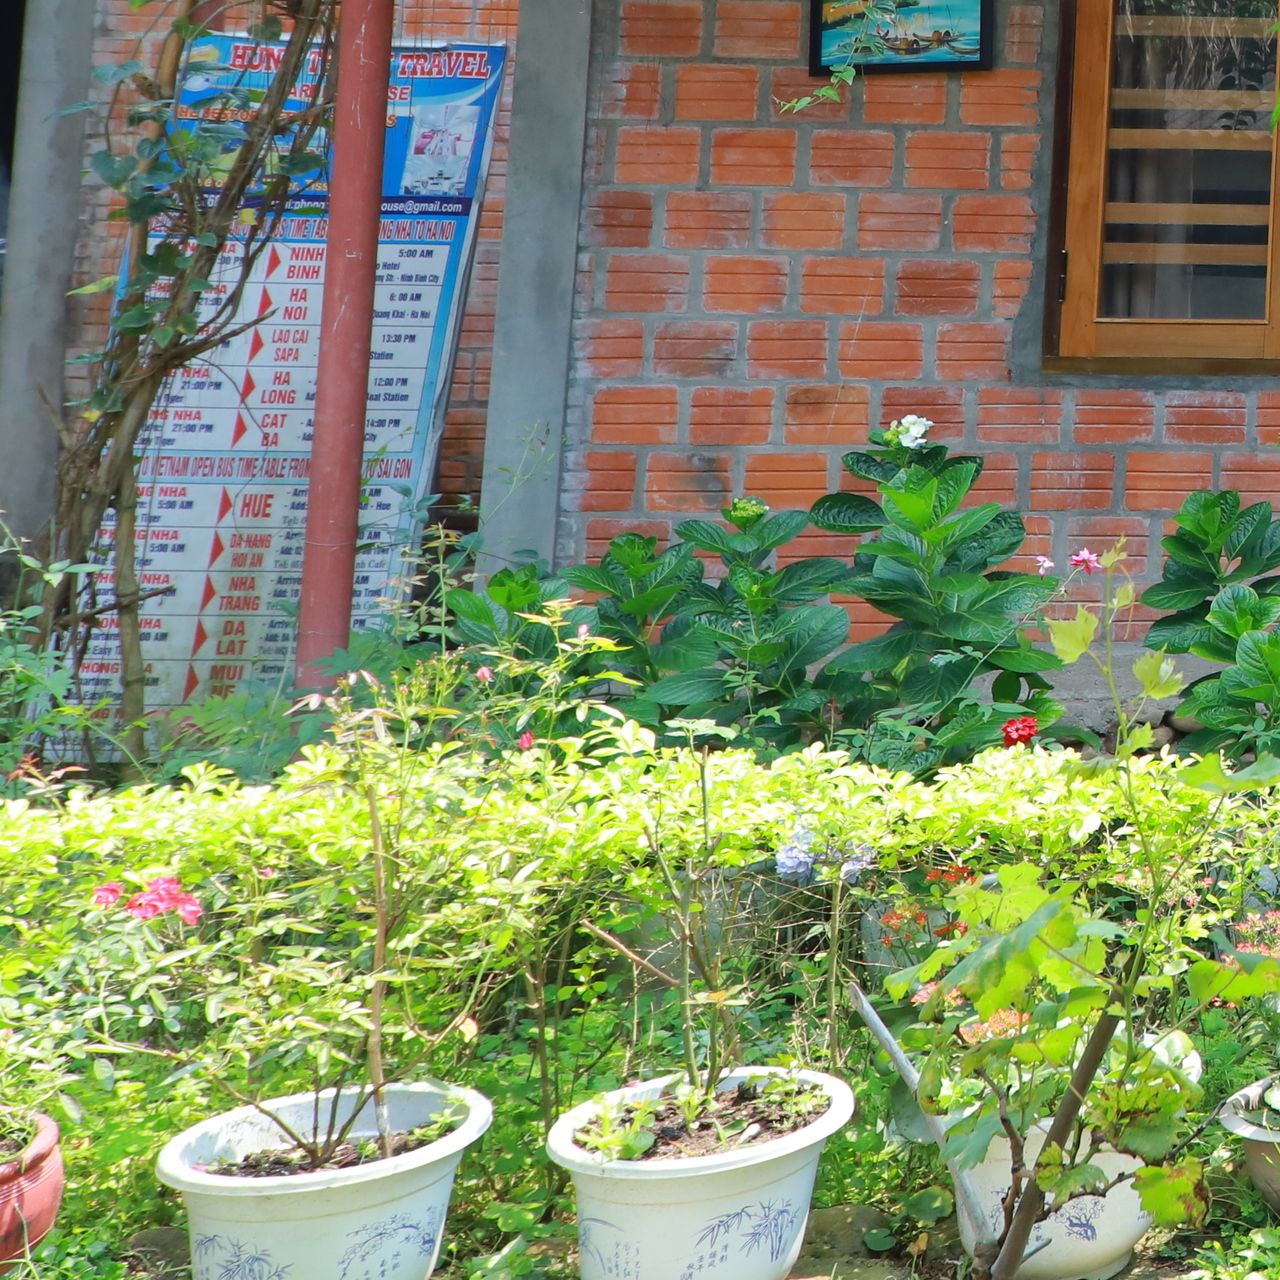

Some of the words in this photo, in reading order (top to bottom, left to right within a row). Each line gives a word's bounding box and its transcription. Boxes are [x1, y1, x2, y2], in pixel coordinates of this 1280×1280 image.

[229, 43, 287, 74] HUN
[397, 51, 492, 79] TRAVEL
[381, 200, 463, 214] ouse@gmail.com
[311, 219, 328, 239] TAB
[395, 220, 413, 240] NHA
[415, 221, 426, 240] TO
[426, 221, 437, 240] HA
[438, 221, 456, 240] NOI
[290, 247, 325, 262] NINH
[419, 249, 434, 258] AM
[286, 265, 321, 280] BINH
[289, 288, 308, 302] HA
[409, 293, 422, 302] AM
[282, 306, 307, 320] NOI
[272, 329, 292, 344] LAO
[293, 330, 309, 345] CAI
[403, 334, 416, 343] PM
[273, 347, 300, 362] SAPA
[182, 368, 211, 378] NHA
[272, 371, 291, 386] HA
[207, 381, 222, 390] PM
[395, 378, 408, 387] PM
[260, 390, 296, 404] LONG
[383, 392, 409, 402] Station
[173, 410, 202, 421] NHA
[260, 414, 287, 428] CAT
[198, 424, 214, 433] PM
[388, 419, 401, 428] PM
[261, 432, 279, 447] BA
[191, 456, 215, 477] OPEN
[216, 457, 236, 478] BUS
[237, 457, 259, 478] TIME
[261, 458, 288, 478] TABLE
[377, 458, 393, 478] SAI
[393, 459, 412, 479] GON
[158, 487, 187, 497] NHA
[369, 488, 382, 498] AM
[178, 501, 194, 510] AM
[239, 494, 274, 518] HUE
[150, 530, 179, 541] NHA
[367, 531, 381, 540] AM
[170, 544, 185, 552] AM
[249, 553, 264, 568] AN
[142, 574, 170, 584] NHA
[228, 576, 256, 591] NHA
[218, 595, 261, 611] TRANG
[222, 620, 246, 636] DA
[153, 632, 168, 641] AM
[215, 640, 247, 656] LAT
[80, 663, 120, 674] HONG
[209, 665, 244, 680] MUI
